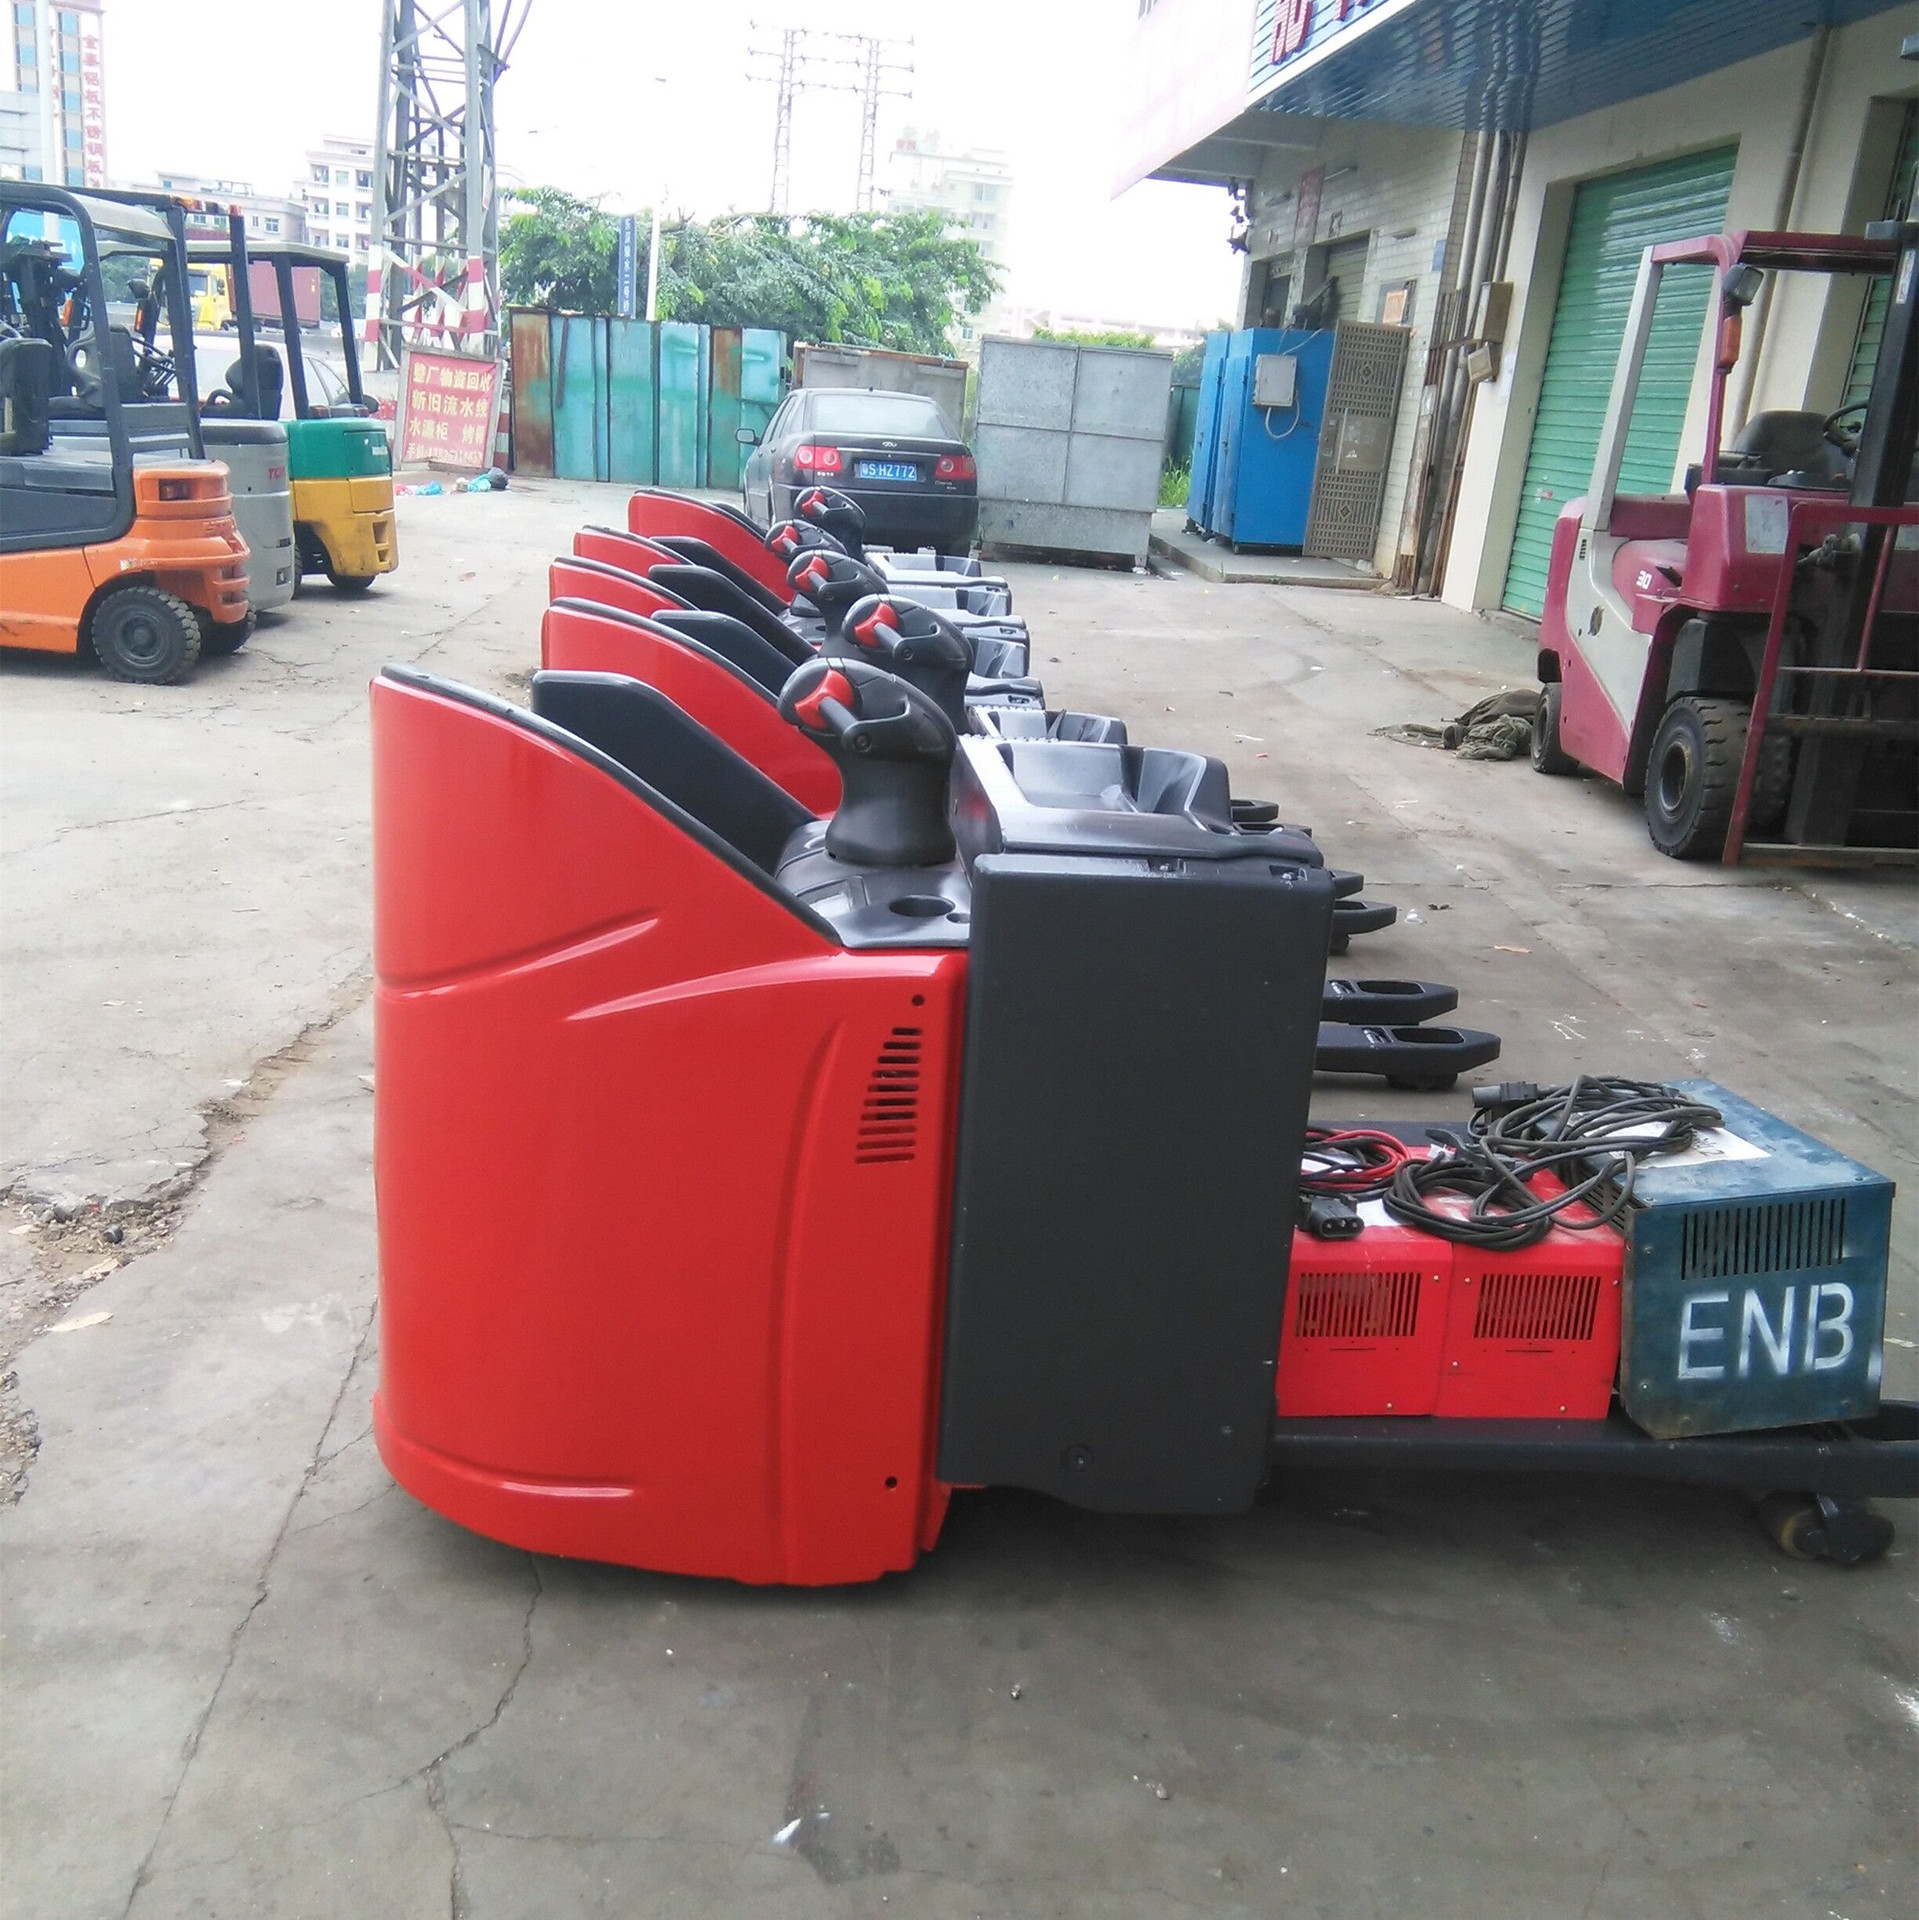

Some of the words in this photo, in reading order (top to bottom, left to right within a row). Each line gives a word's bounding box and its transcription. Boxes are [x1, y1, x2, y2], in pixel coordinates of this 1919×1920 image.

[413, 362, 493, 392] 整厂物资回收
[412, 389, 489, 418] 新旧流水线
[1636, 570, 1652, 590] 30
[1678, 1282, 1853, 1379] ENB
